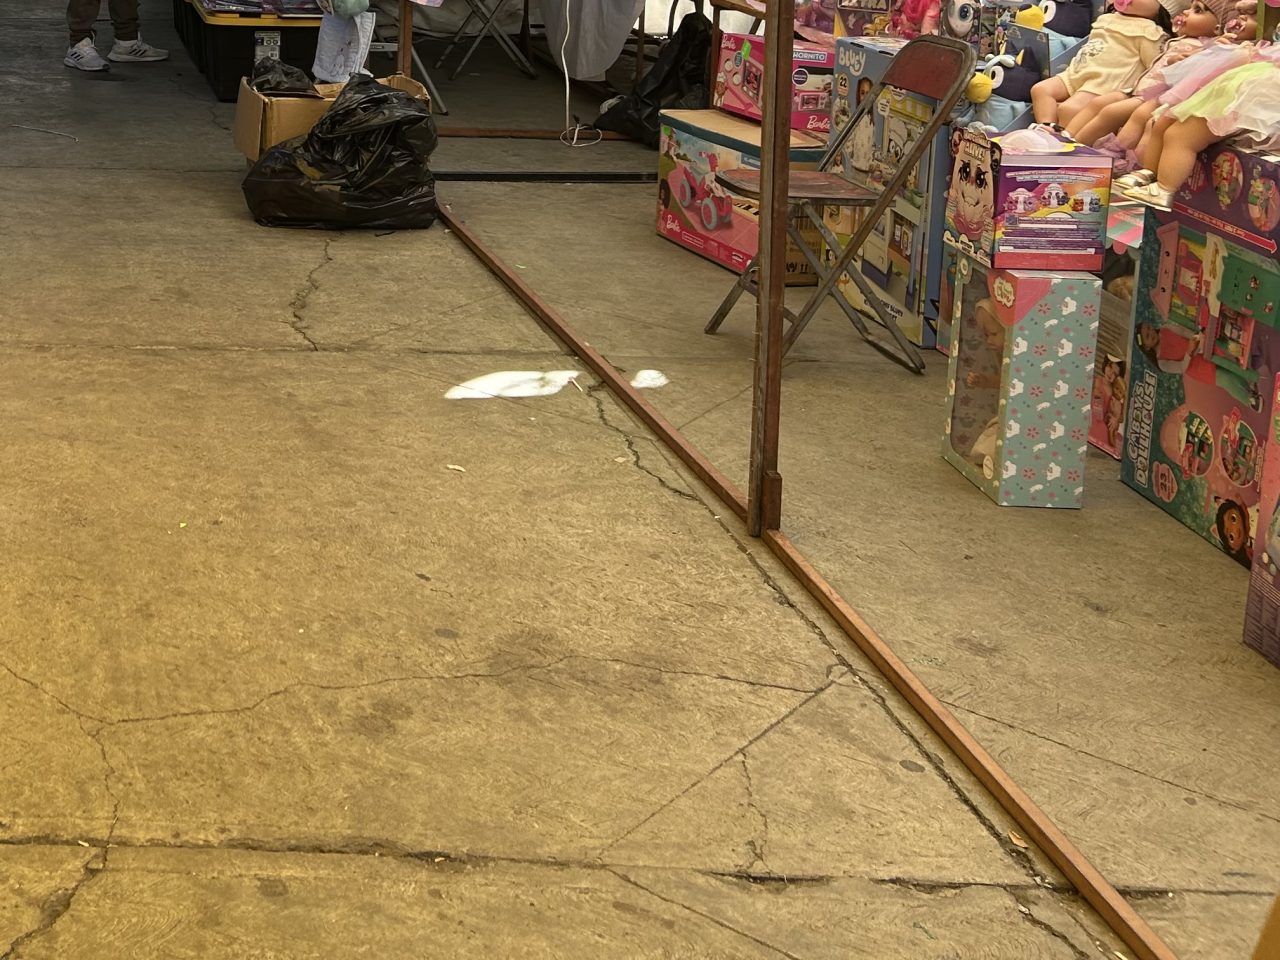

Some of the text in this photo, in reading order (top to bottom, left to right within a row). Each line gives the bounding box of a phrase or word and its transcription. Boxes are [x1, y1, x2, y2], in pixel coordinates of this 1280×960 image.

[839, 46, 866, 77] BLUEY
[839, 75, 849, 88] 22
[1135, 369, 1158, 489] DOLLHOUSE
